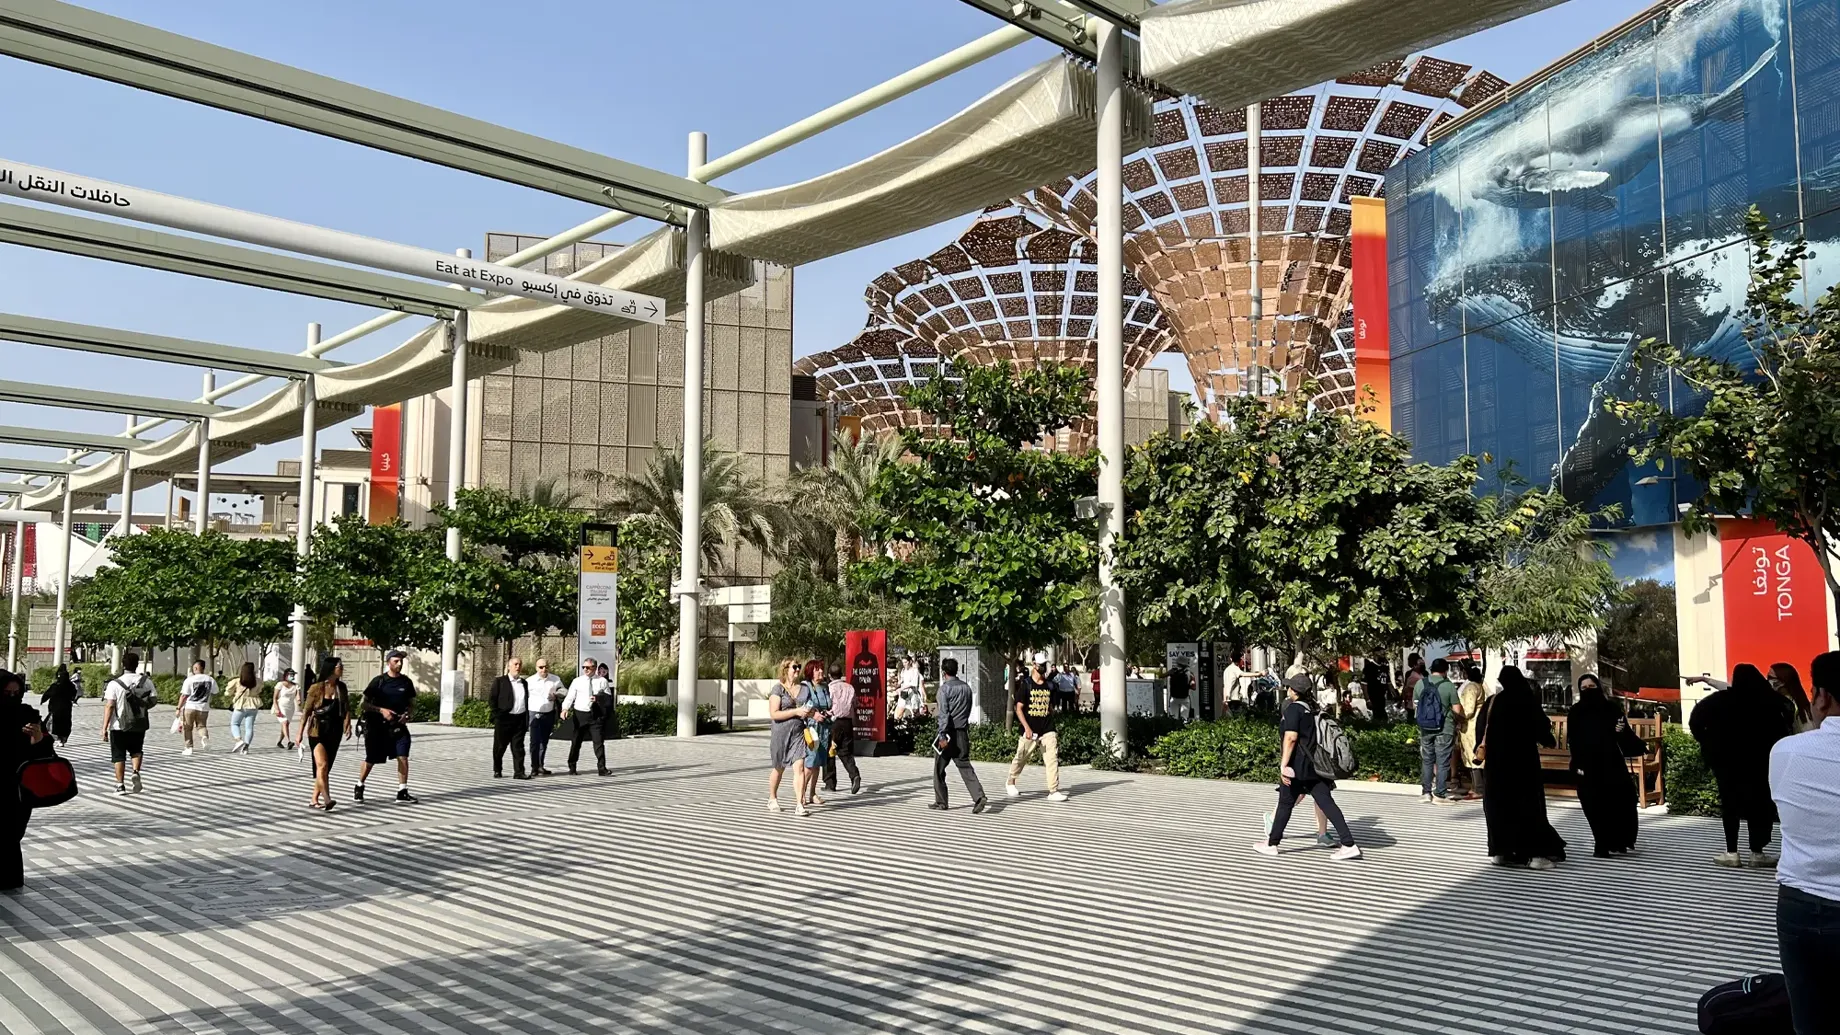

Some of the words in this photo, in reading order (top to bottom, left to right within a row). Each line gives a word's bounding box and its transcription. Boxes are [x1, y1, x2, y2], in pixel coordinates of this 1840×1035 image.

[18, 174, 64, 195] النقل
[70, 186, 131, 207] حافلات
[436, 260, 459, 275] Eat
[462, 268, 477, 279] at
[480, 270, 513, 286] Expo
[522, 280, 558, 298] إكسبو
[560, 288, 581, 303] في
[1752, 546, 1770, 595] تونغا
[1775, 544, 1793, 622] TONGA
